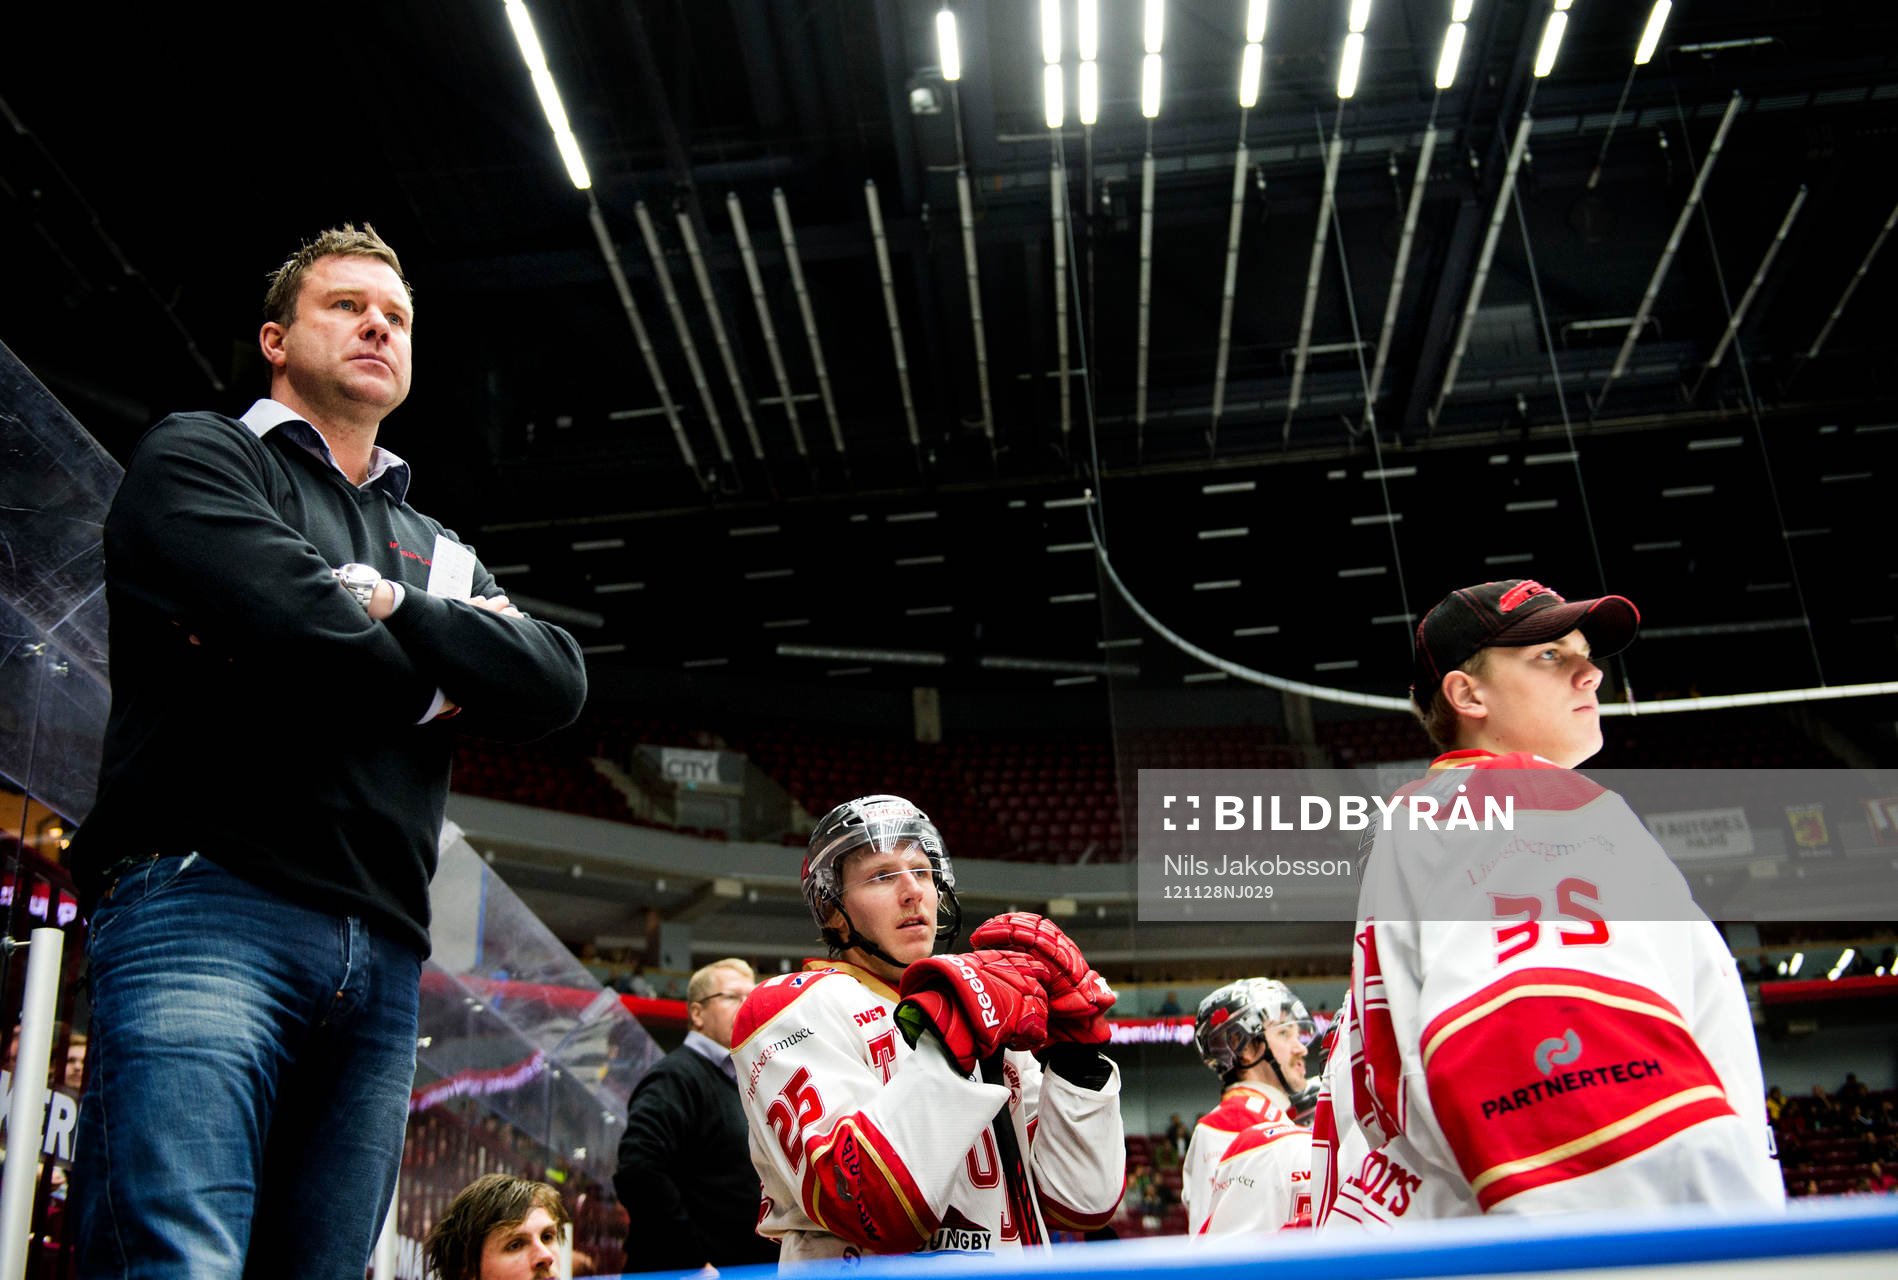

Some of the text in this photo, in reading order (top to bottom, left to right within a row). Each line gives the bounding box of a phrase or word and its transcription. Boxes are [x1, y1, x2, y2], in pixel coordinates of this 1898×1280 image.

[667, 758, 713, 779] CITY
[1480, 1058, 1664, 1120] PARTNERTECH
[766, 1065, 825, 1176] 25
